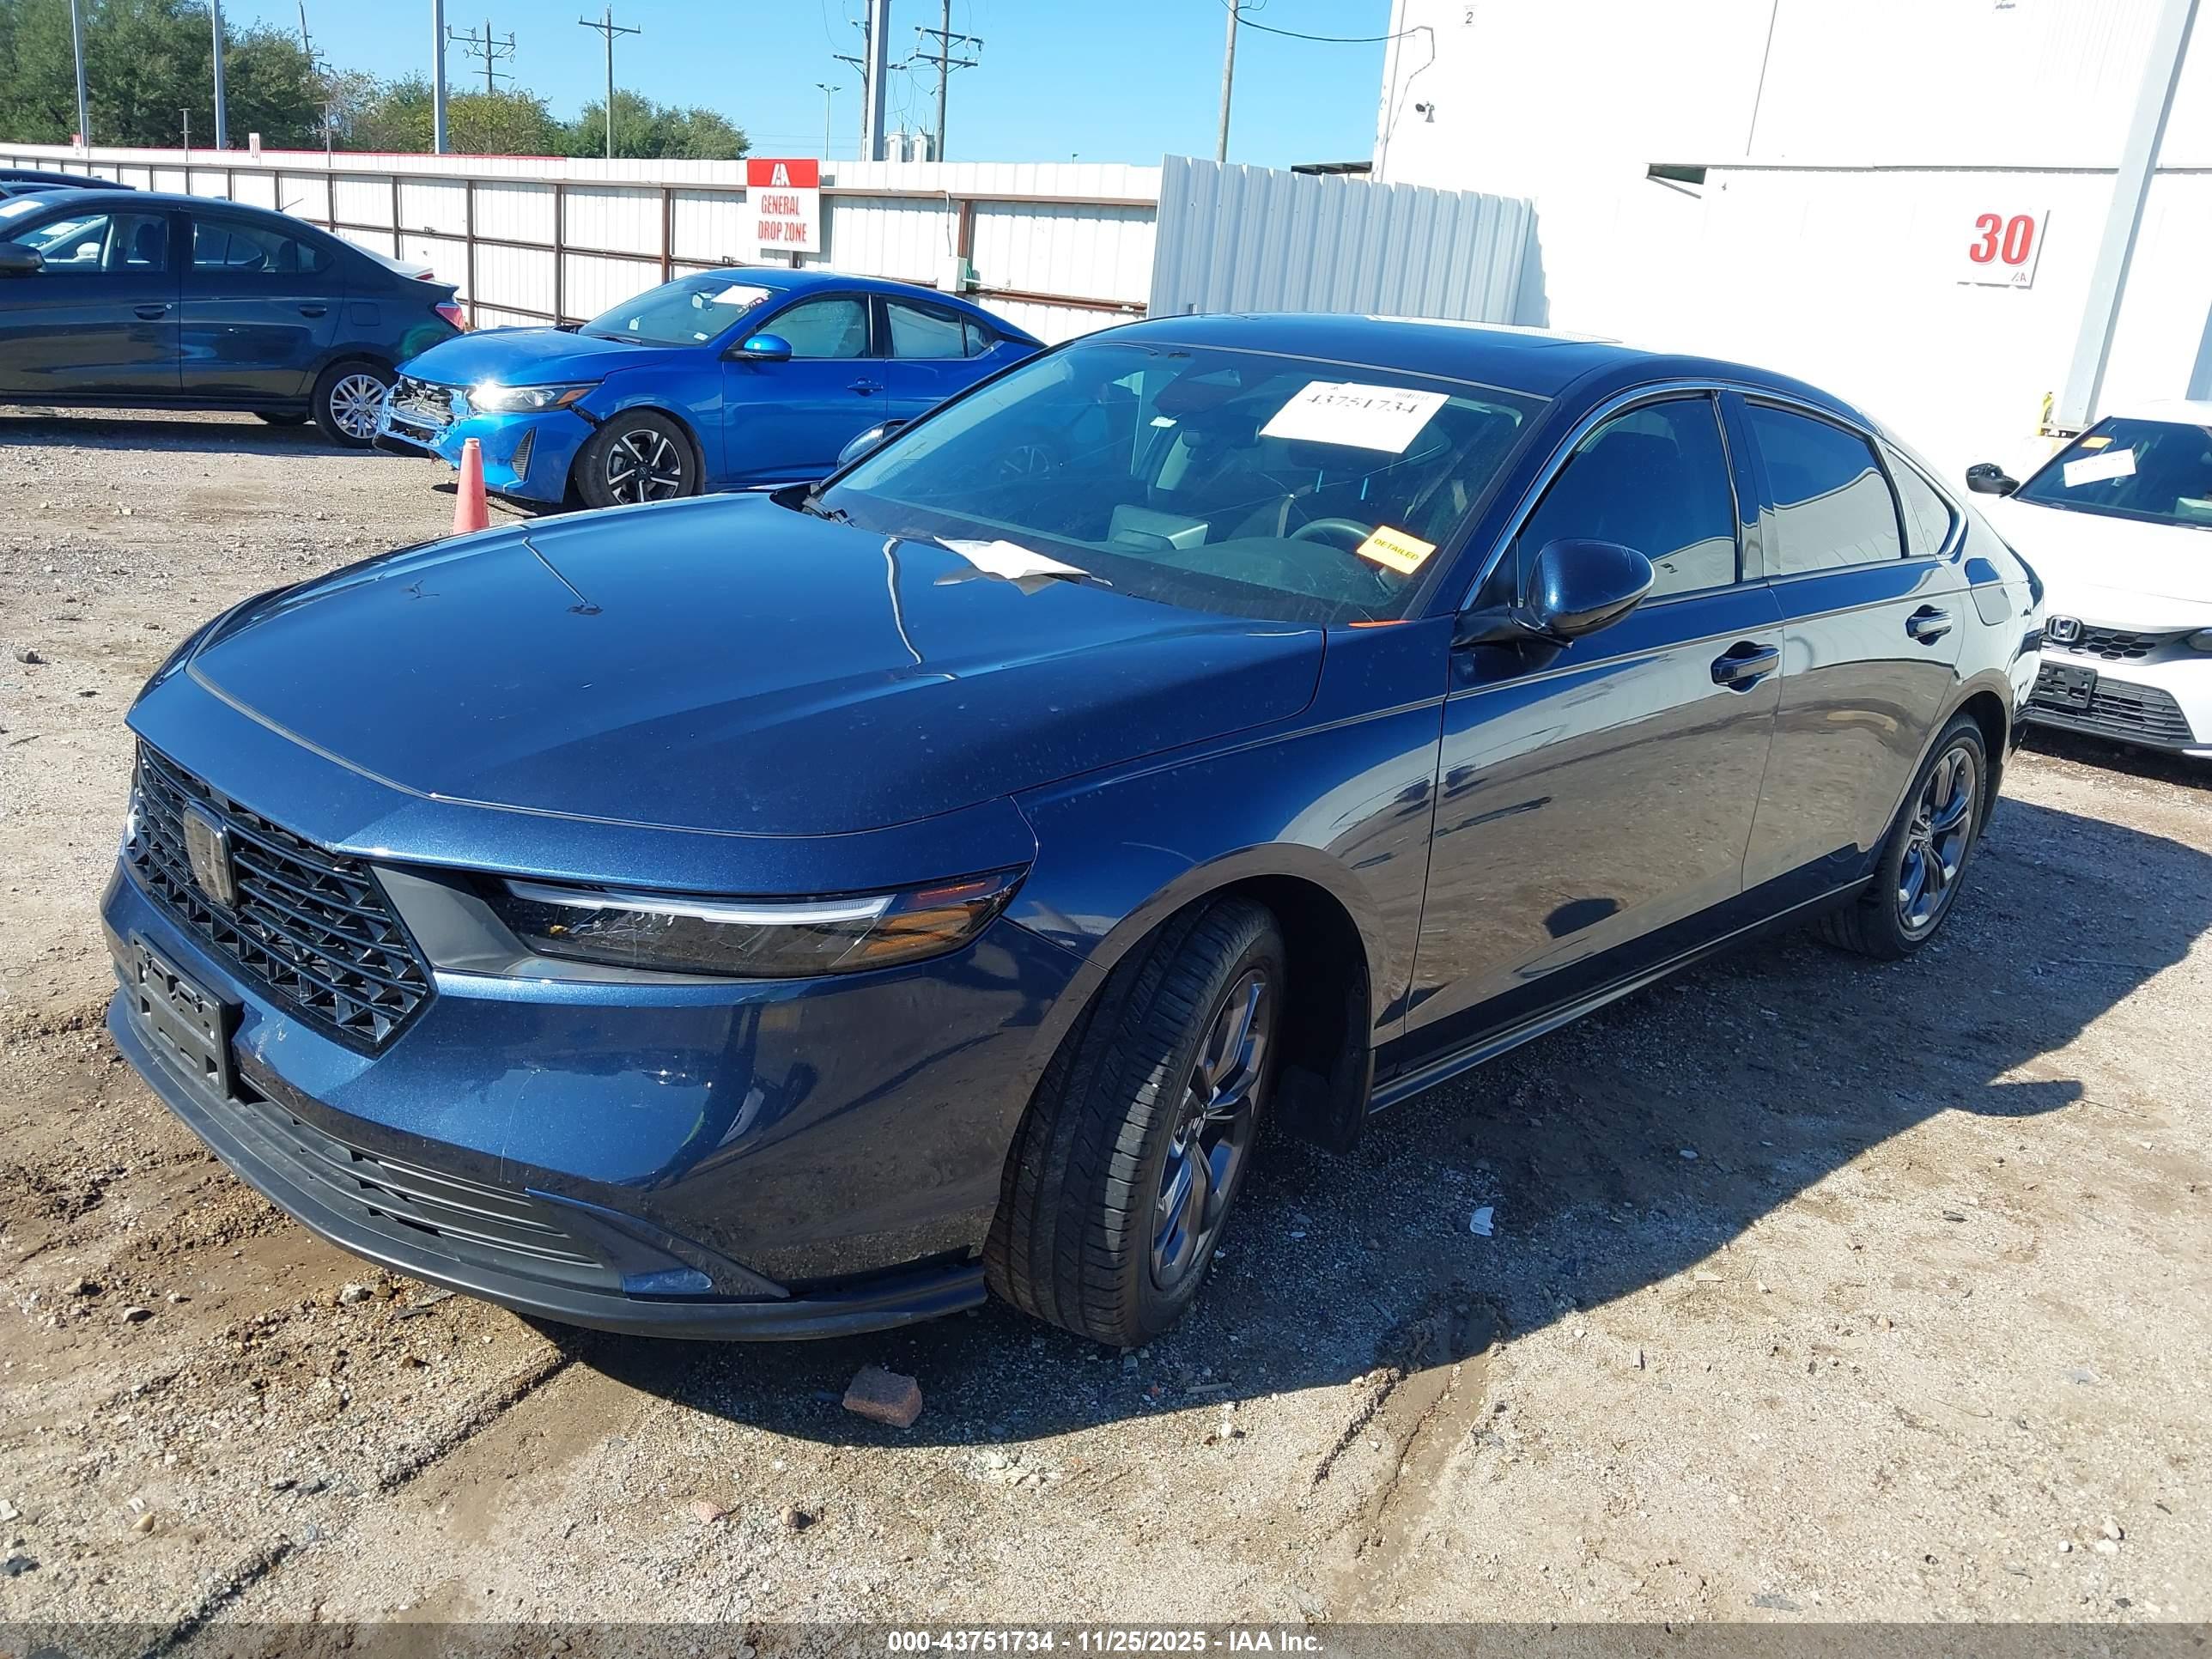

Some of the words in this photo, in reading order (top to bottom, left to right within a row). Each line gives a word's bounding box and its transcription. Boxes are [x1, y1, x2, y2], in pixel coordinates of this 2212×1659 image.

[1465, 11, 1474, 24] 2
[761, 194, 799, 216] GENERAL
[757, 220, 782, 240] DROP
[784, 222, 807, 242] ZONE
[1969, 213, 2035, 265] 30
[1374, 538, 1419, 561] DETAILED
